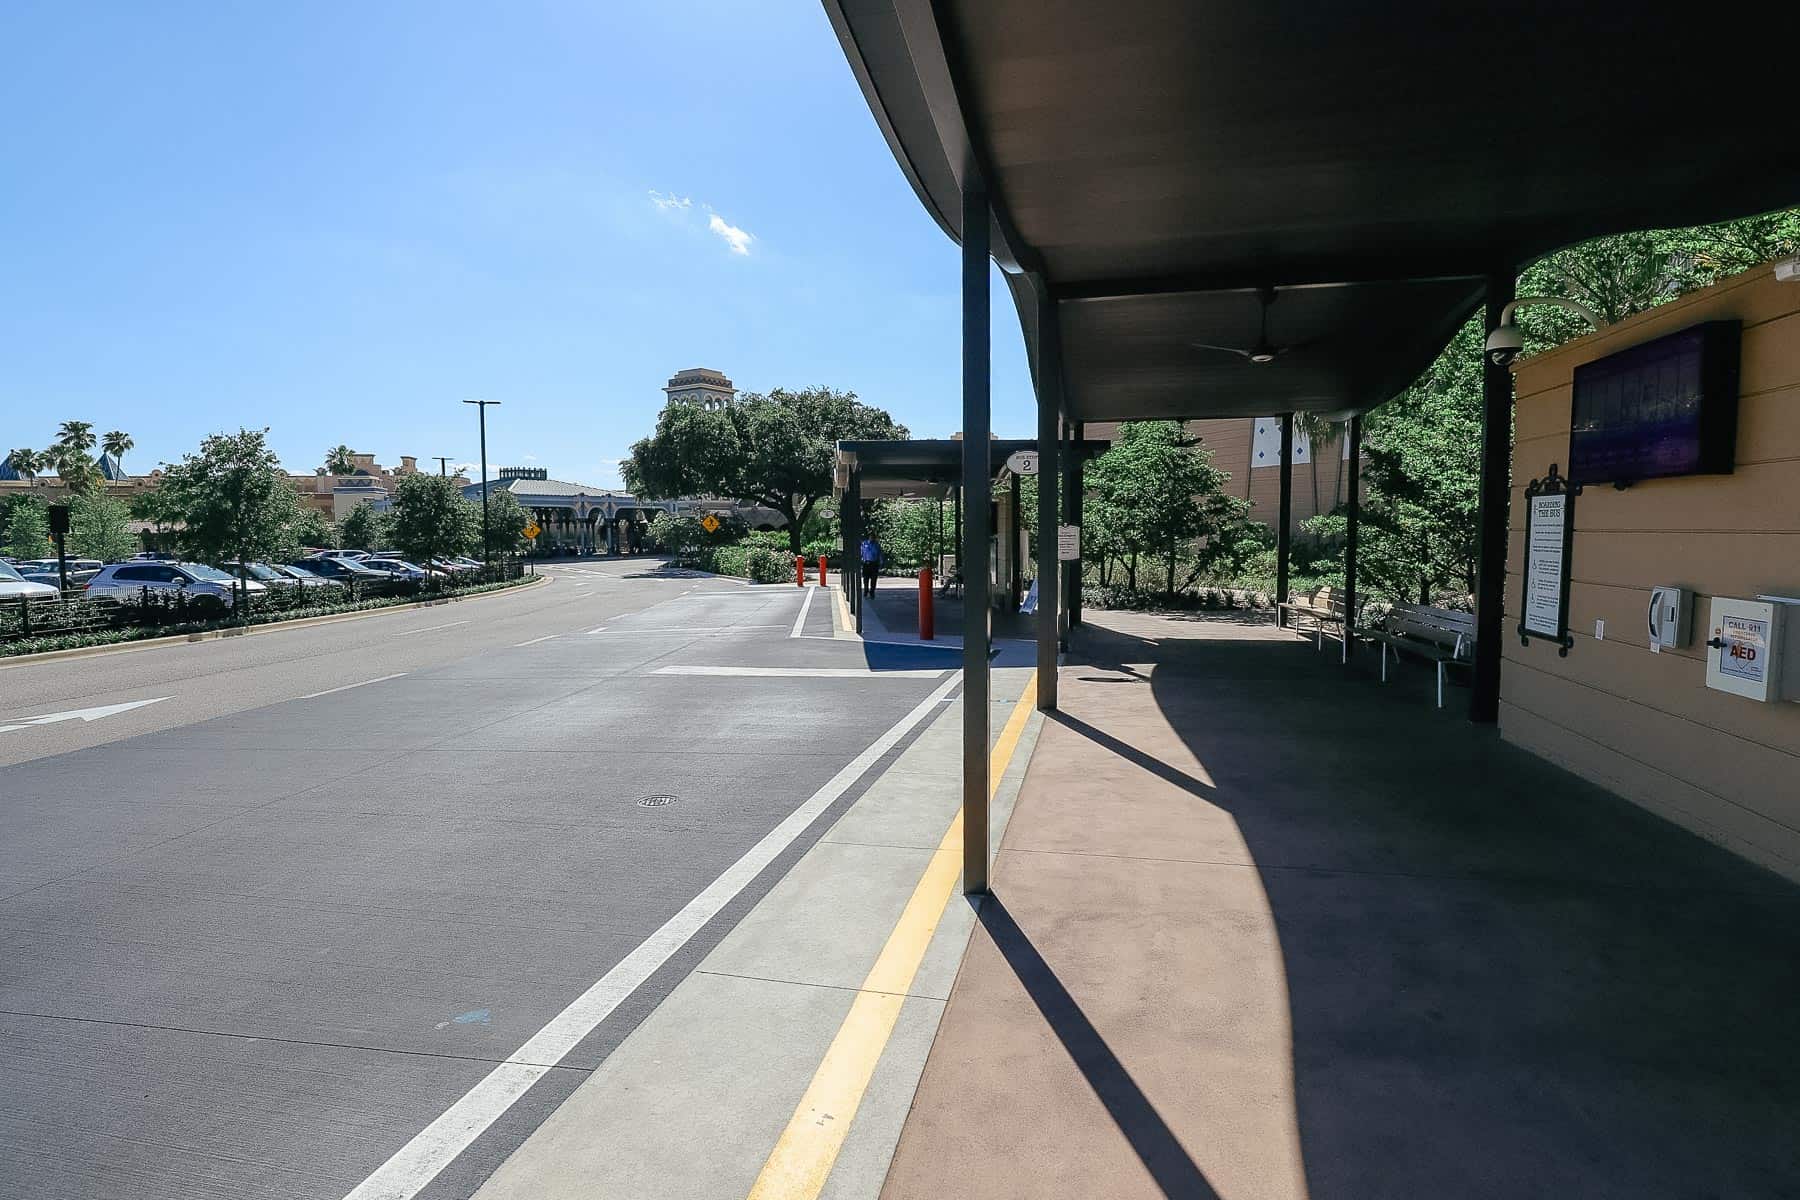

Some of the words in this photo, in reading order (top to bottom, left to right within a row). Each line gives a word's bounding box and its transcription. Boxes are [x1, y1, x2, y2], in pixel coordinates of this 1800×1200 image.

[1023, 459, 1032, 471] 2
[1538, 501, 1561, 509] BOARDING
[1538, 509, 1549, 518] THE
[1549, 509, 1561, 518] BUS
[1728, 621, 1746, 630] CALL
[1748, 624, 1761, 633] 911
[1730, 645, 1756, 661] AED
